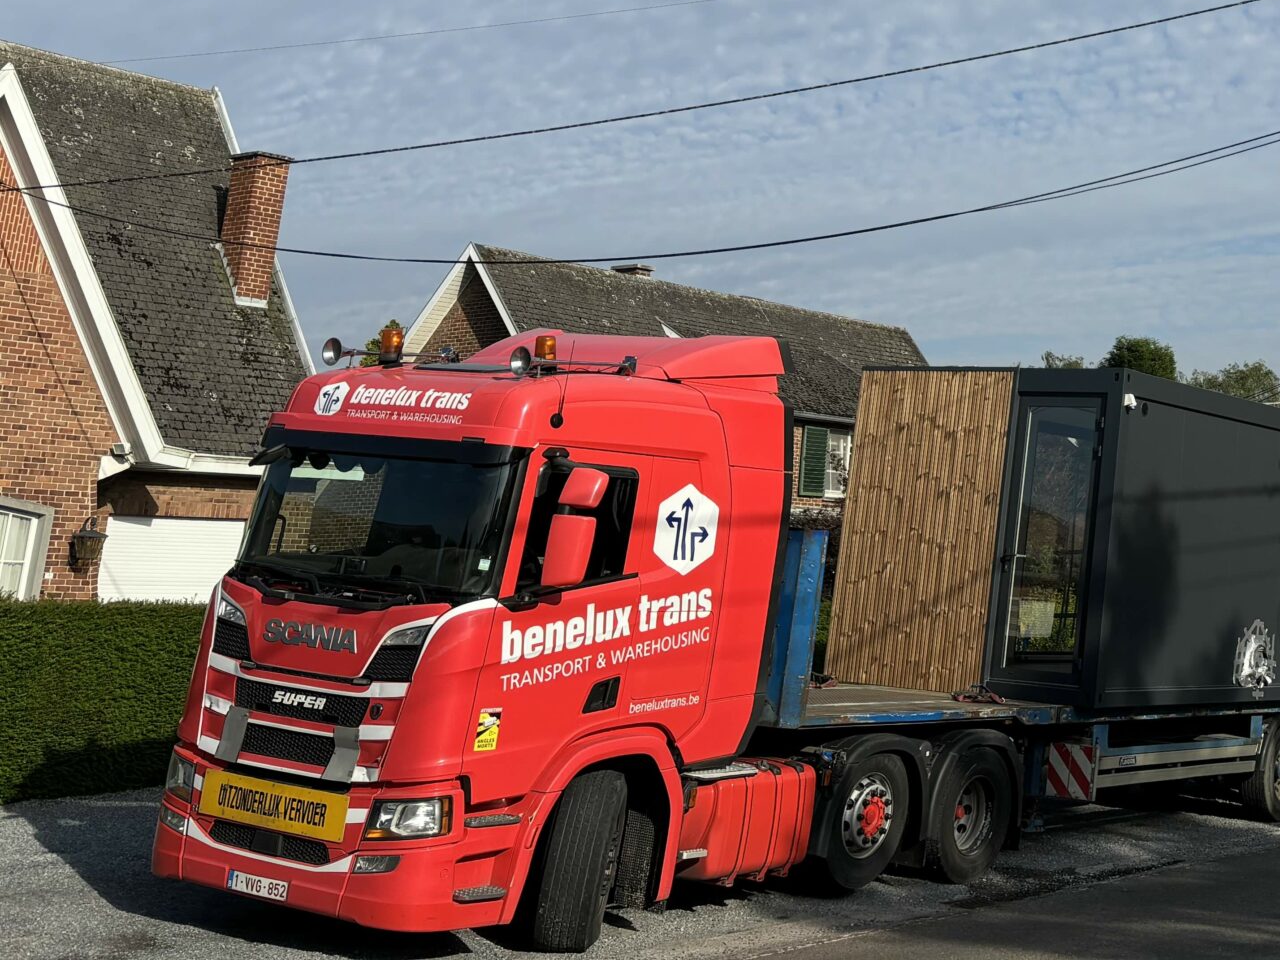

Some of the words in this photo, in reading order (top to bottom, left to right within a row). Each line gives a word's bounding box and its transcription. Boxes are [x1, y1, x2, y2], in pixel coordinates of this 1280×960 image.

[350, 384, 422, 407] benelux
[420, 389, 472, 410] trans
[346, 409, 391, 420] TRANSPORT
[391, 412, 398, 421] &
[399, 412, 462, 425] WAREHOUSING
[263, 618, 357, 654] SCANIA
[501, 603, 632, 664] benelux
[638, 588, 712, 632] trans
[500, 655, 592, 691] TRANSPORT
[596, 653, 606, 668] &
[611, 627, 710, 664] WAREHOUSING
[272, 690, 326, 710] SUPER
[629, 694, 699, 714] beneluxtrans.be
[218, 783, 283, 819] UITZONDERLIJK
[283, 796, 328, 828] VERVOER
[234, 874, 287, 899] 1-VVG-852
